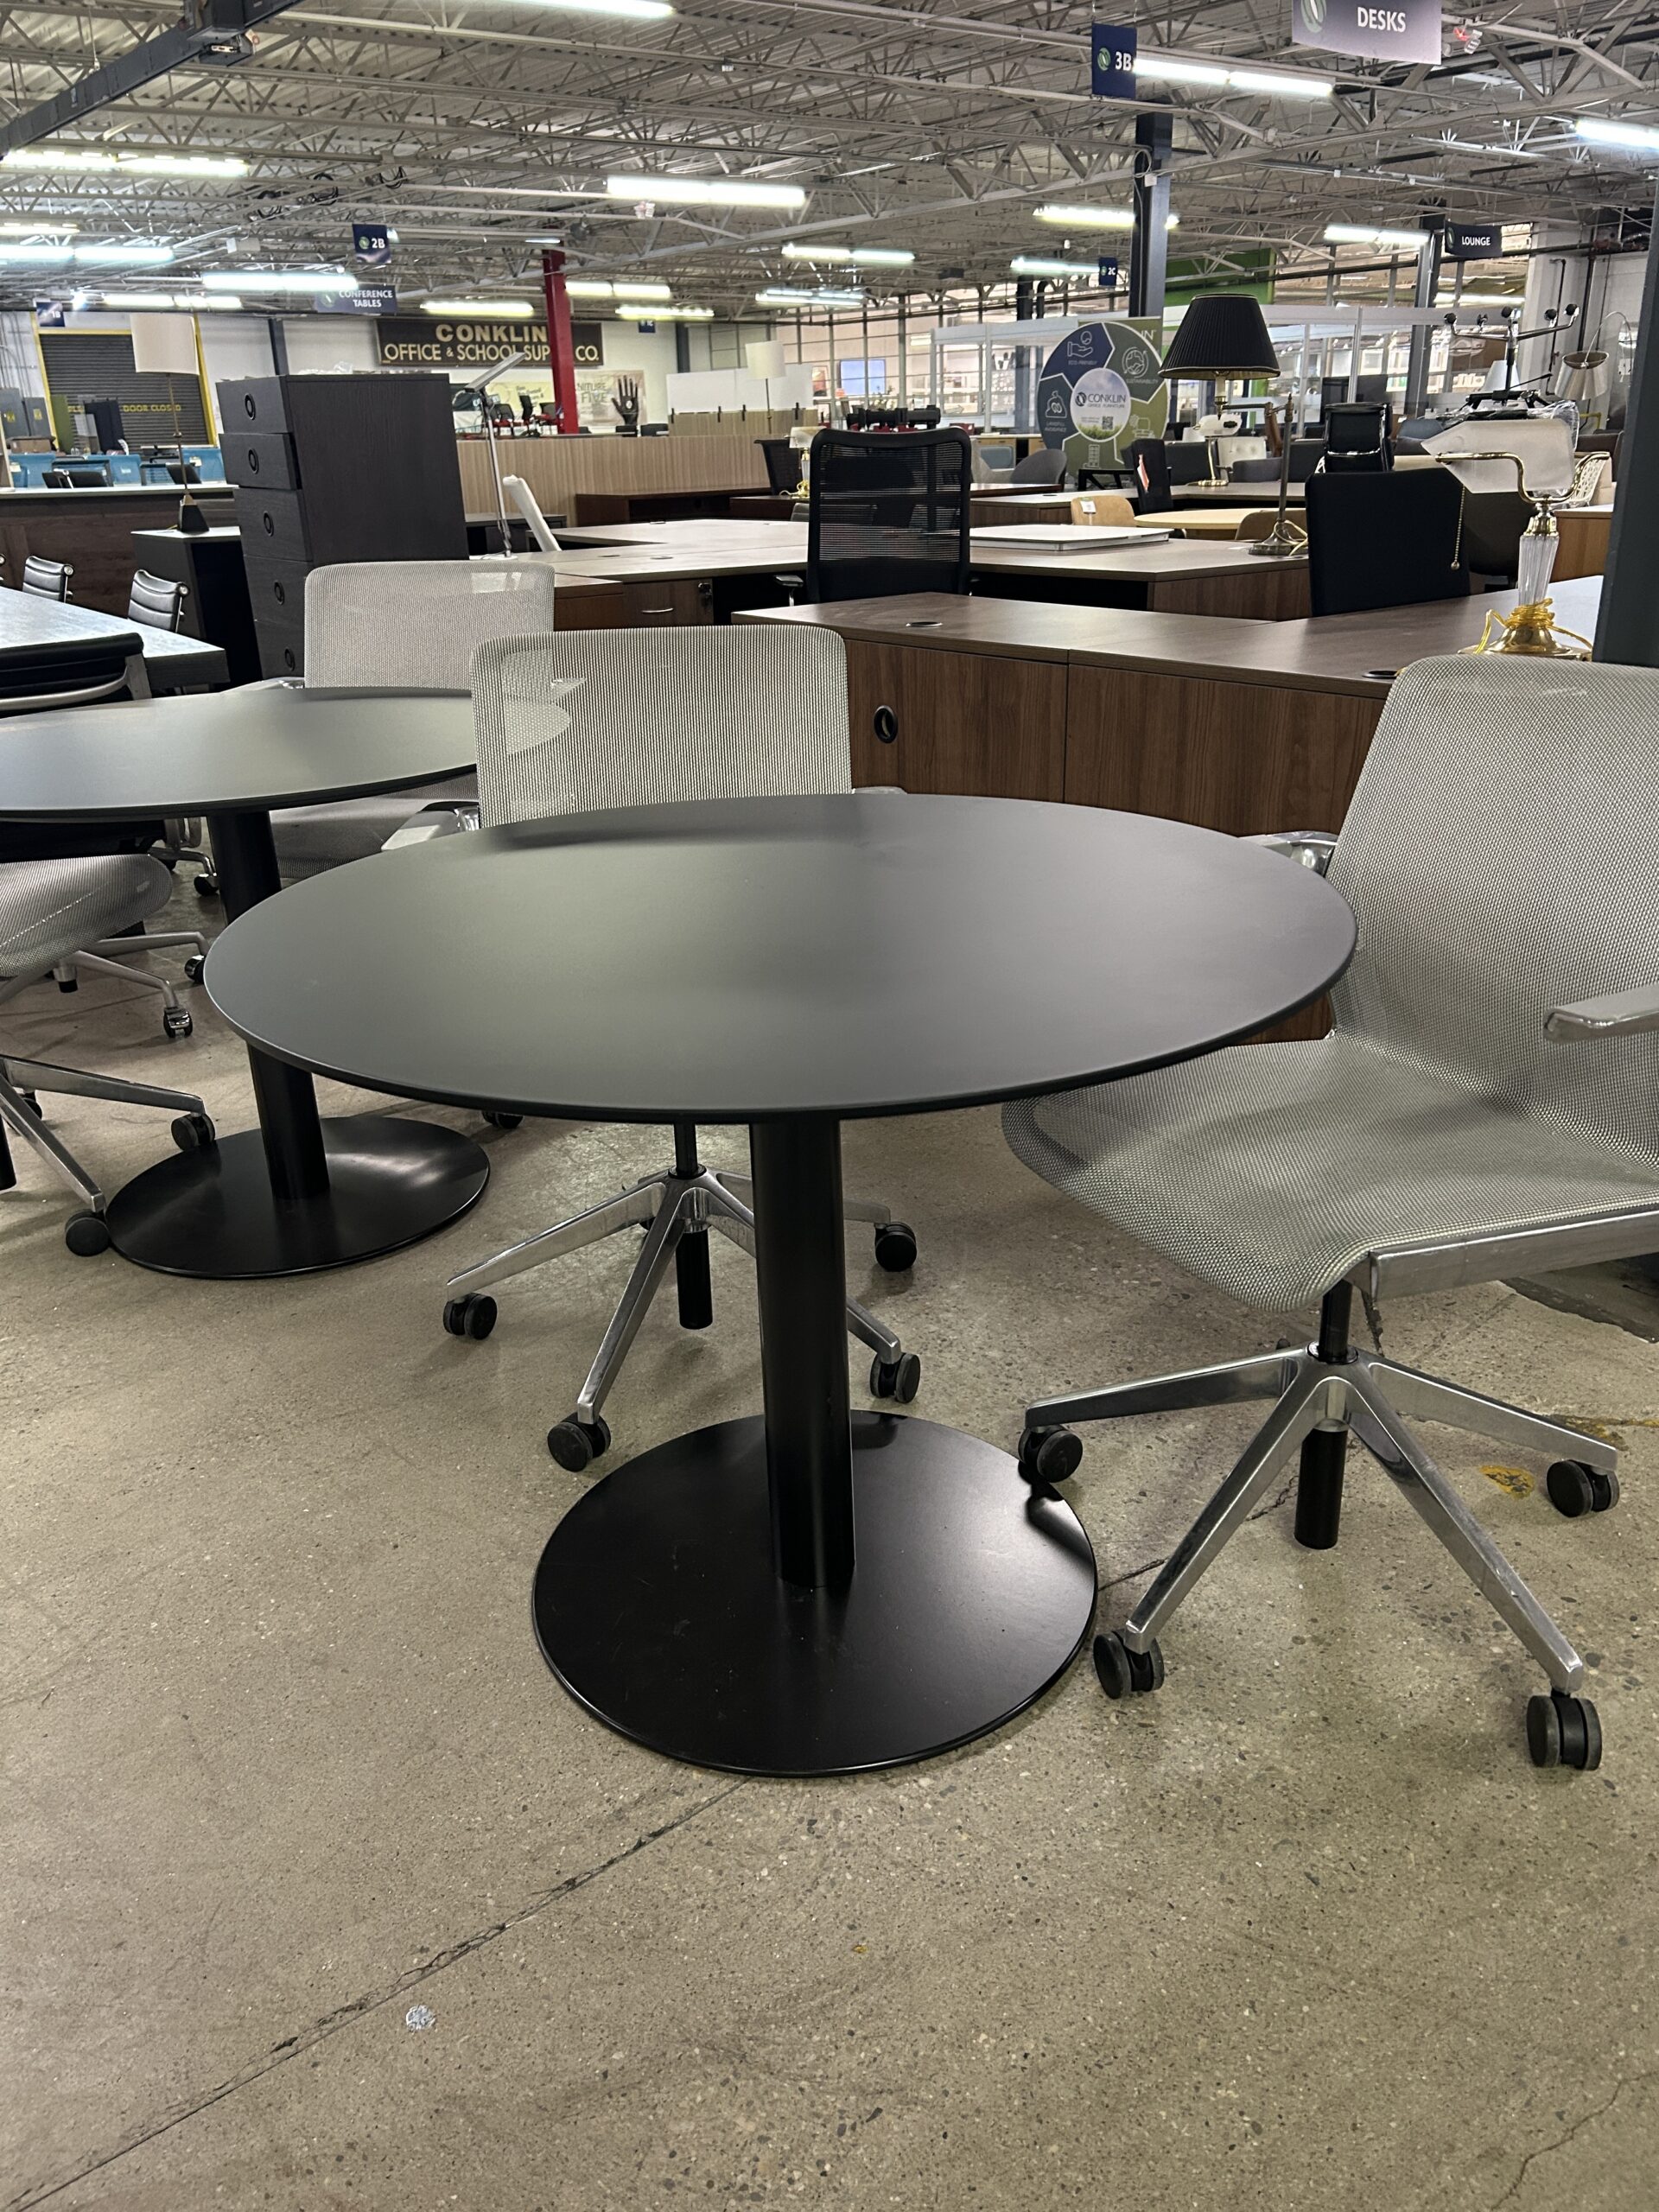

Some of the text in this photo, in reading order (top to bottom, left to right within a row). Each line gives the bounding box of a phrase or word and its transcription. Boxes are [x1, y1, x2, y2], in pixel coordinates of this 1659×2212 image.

[1357, 6, 1406, 33] DESKS
[1115, 51, 1132, 71] 3B
[371, 238, 385, 249] 2B
[1461, 236, 1491, 246] LOUNGE
[339, 289, 393, 298] CONFERENCE
[353, 299, 382, 308] TABLES
[435, 323, 547, 342] CONKLIN
[384, 343, 442, 360] OFFICE
[446, 346, 454, 358] &
[523, 344, 551, 361] SUP
[1088, 393, 1127, 404] CONKLIN
